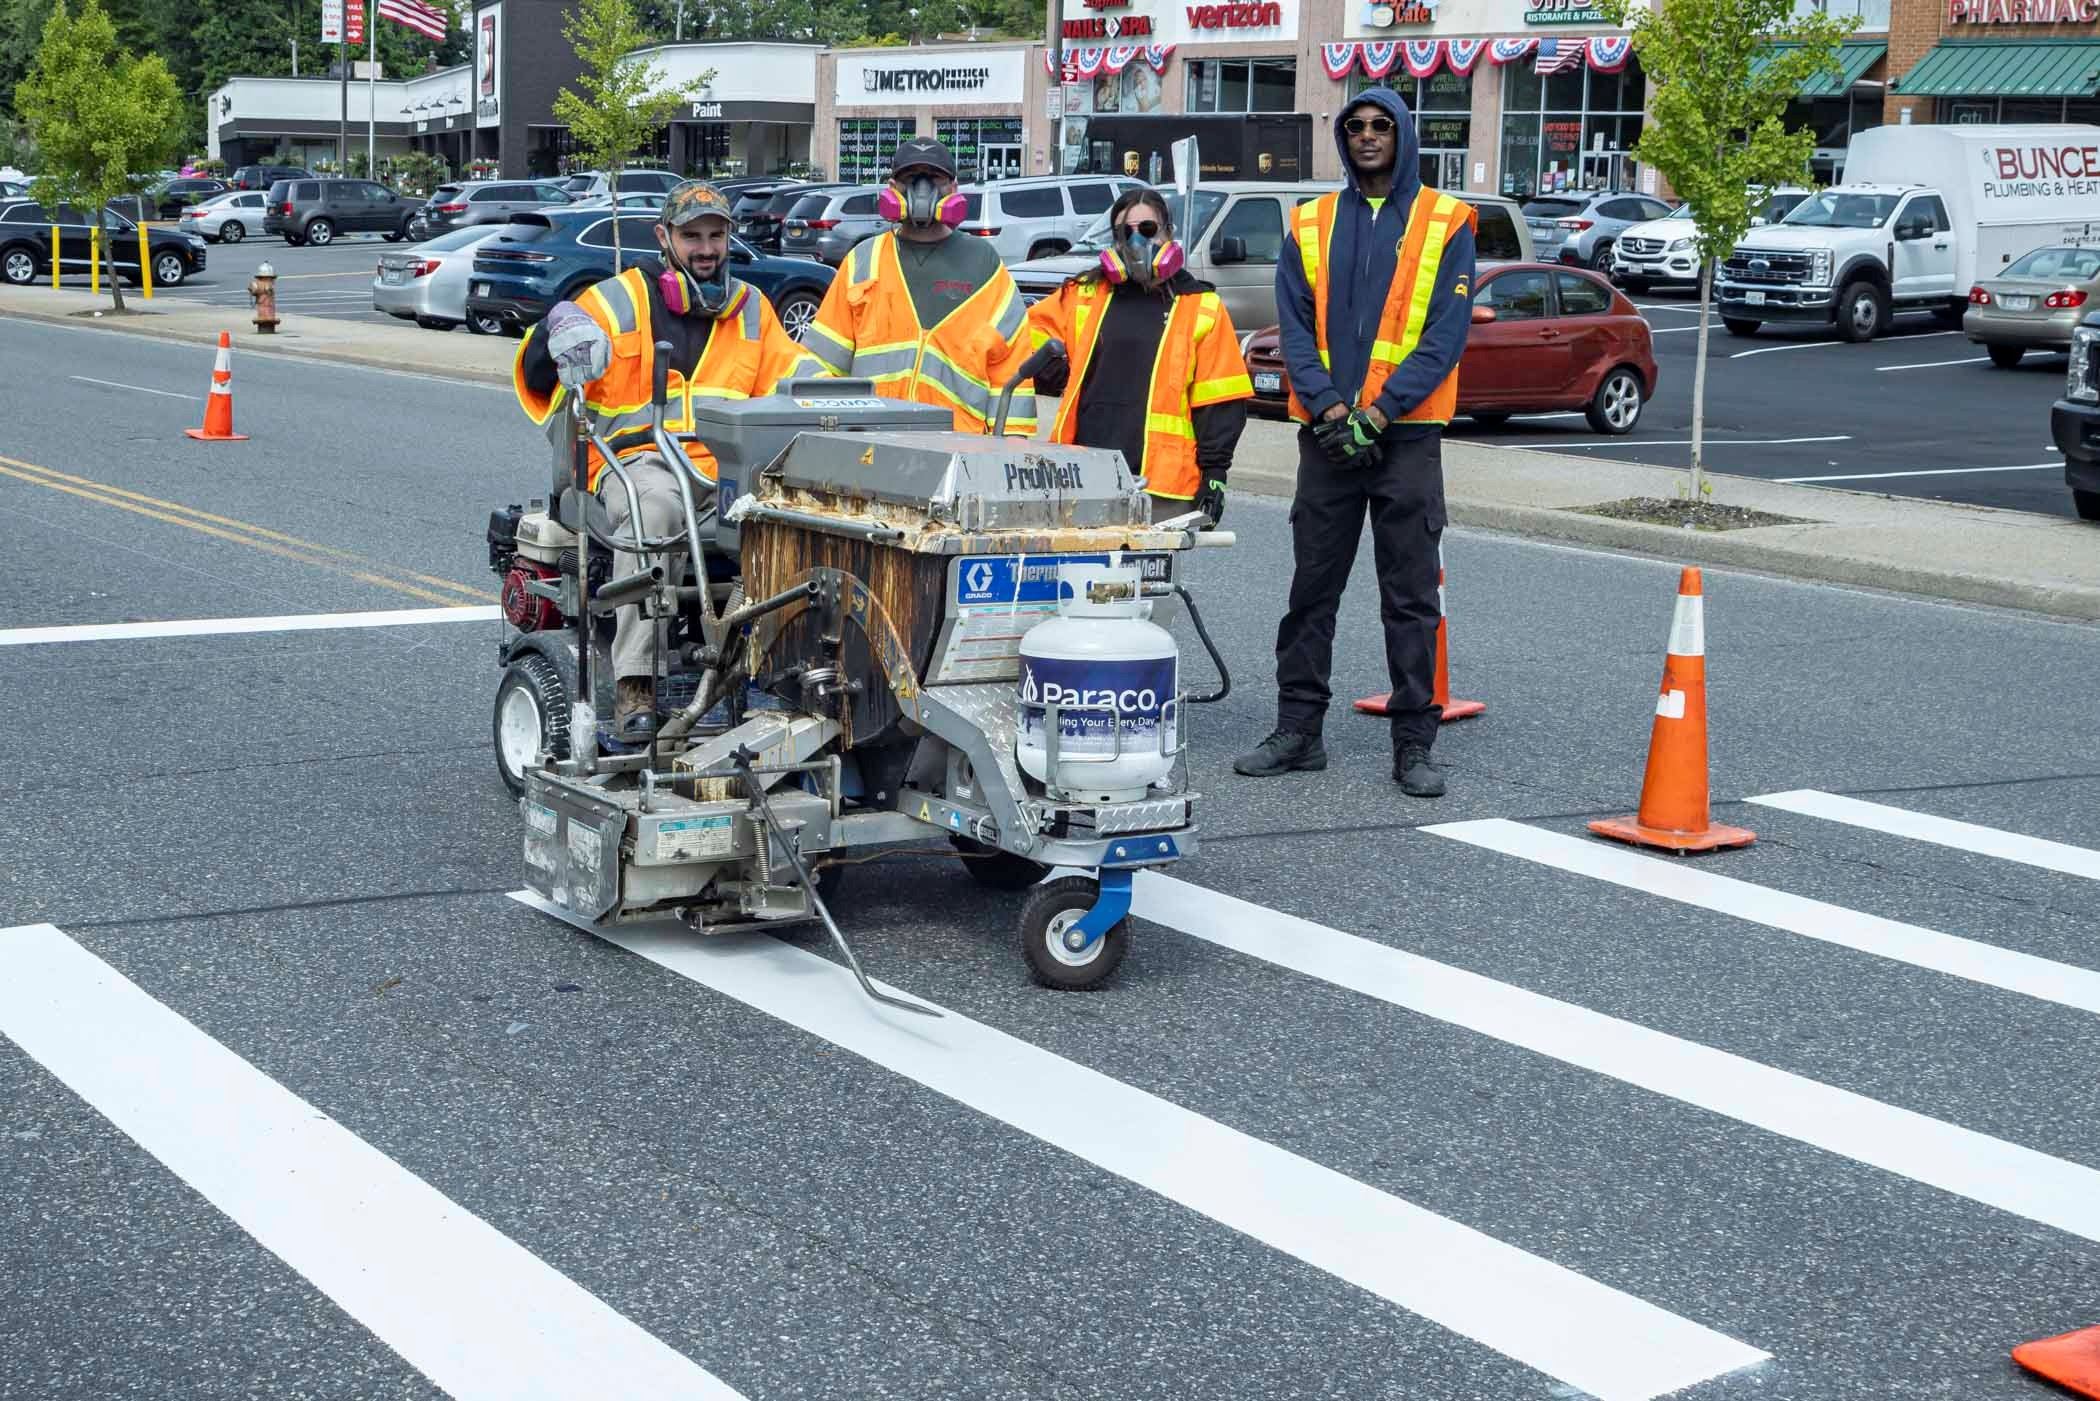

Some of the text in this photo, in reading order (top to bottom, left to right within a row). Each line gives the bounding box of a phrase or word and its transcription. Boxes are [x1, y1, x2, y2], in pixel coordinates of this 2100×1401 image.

[1186, 1, 1280, 29] verizon
[1526, 12, 1571, 22] RISTORANTE
[1573, 12, 1580, 20] &
[1948, 0, 2098, 24] PHARMAC
[1063, 18, 1106, 38] NAILS
[1121, 16, 1152, 36] SPA
[880, 68, 989, 91] METRO PHYSICAL
[946, 79, 984, 88] THERAPY
[693, 103, 722, 118] Paint
[1959, 111, 1983, 124] citi
[1996, 146, 2100, 180] BUNCE
[1984, 182, 2051, 198] PLUMBING
[2053, 181, 2064, 196] &
[1004, 463, 1083, 490] ProMelt
[1043, 682, 1156, 712] Paraco
[1080, 717, 1105, 728] Your
[1108, 717, 1136, 729] Eery
[1138, 716, 1155, 728] Day
